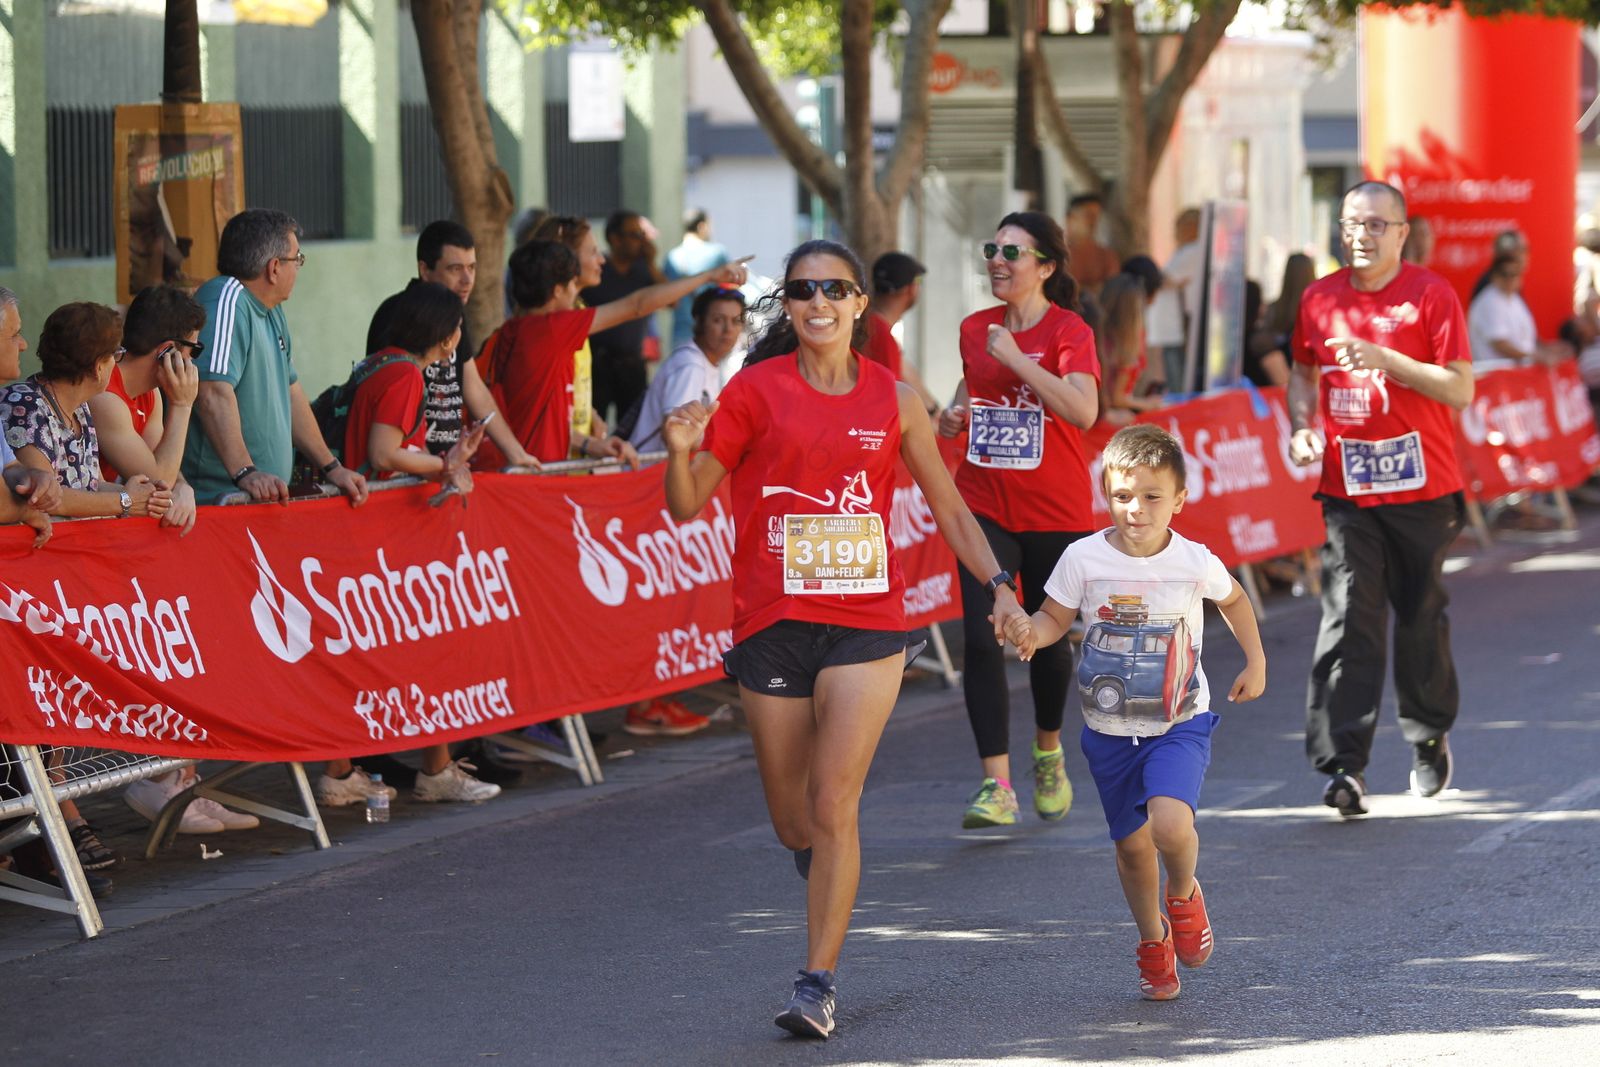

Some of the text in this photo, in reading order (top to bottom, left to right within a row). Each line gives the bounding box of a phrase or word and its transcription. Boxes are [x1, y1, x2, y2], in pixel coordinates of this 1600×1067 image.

[976, 425, 1030, 447] 2223
[1350, 452, 1408, 474] 2107
[808, 518, 819, 535] 6
[605, 496, 735, 600] Santand
[795, 539, 873, 565] 3190
[815, 567, 865, 578] DANI+FELIPE
[300, 531, 520, 655] Santander
